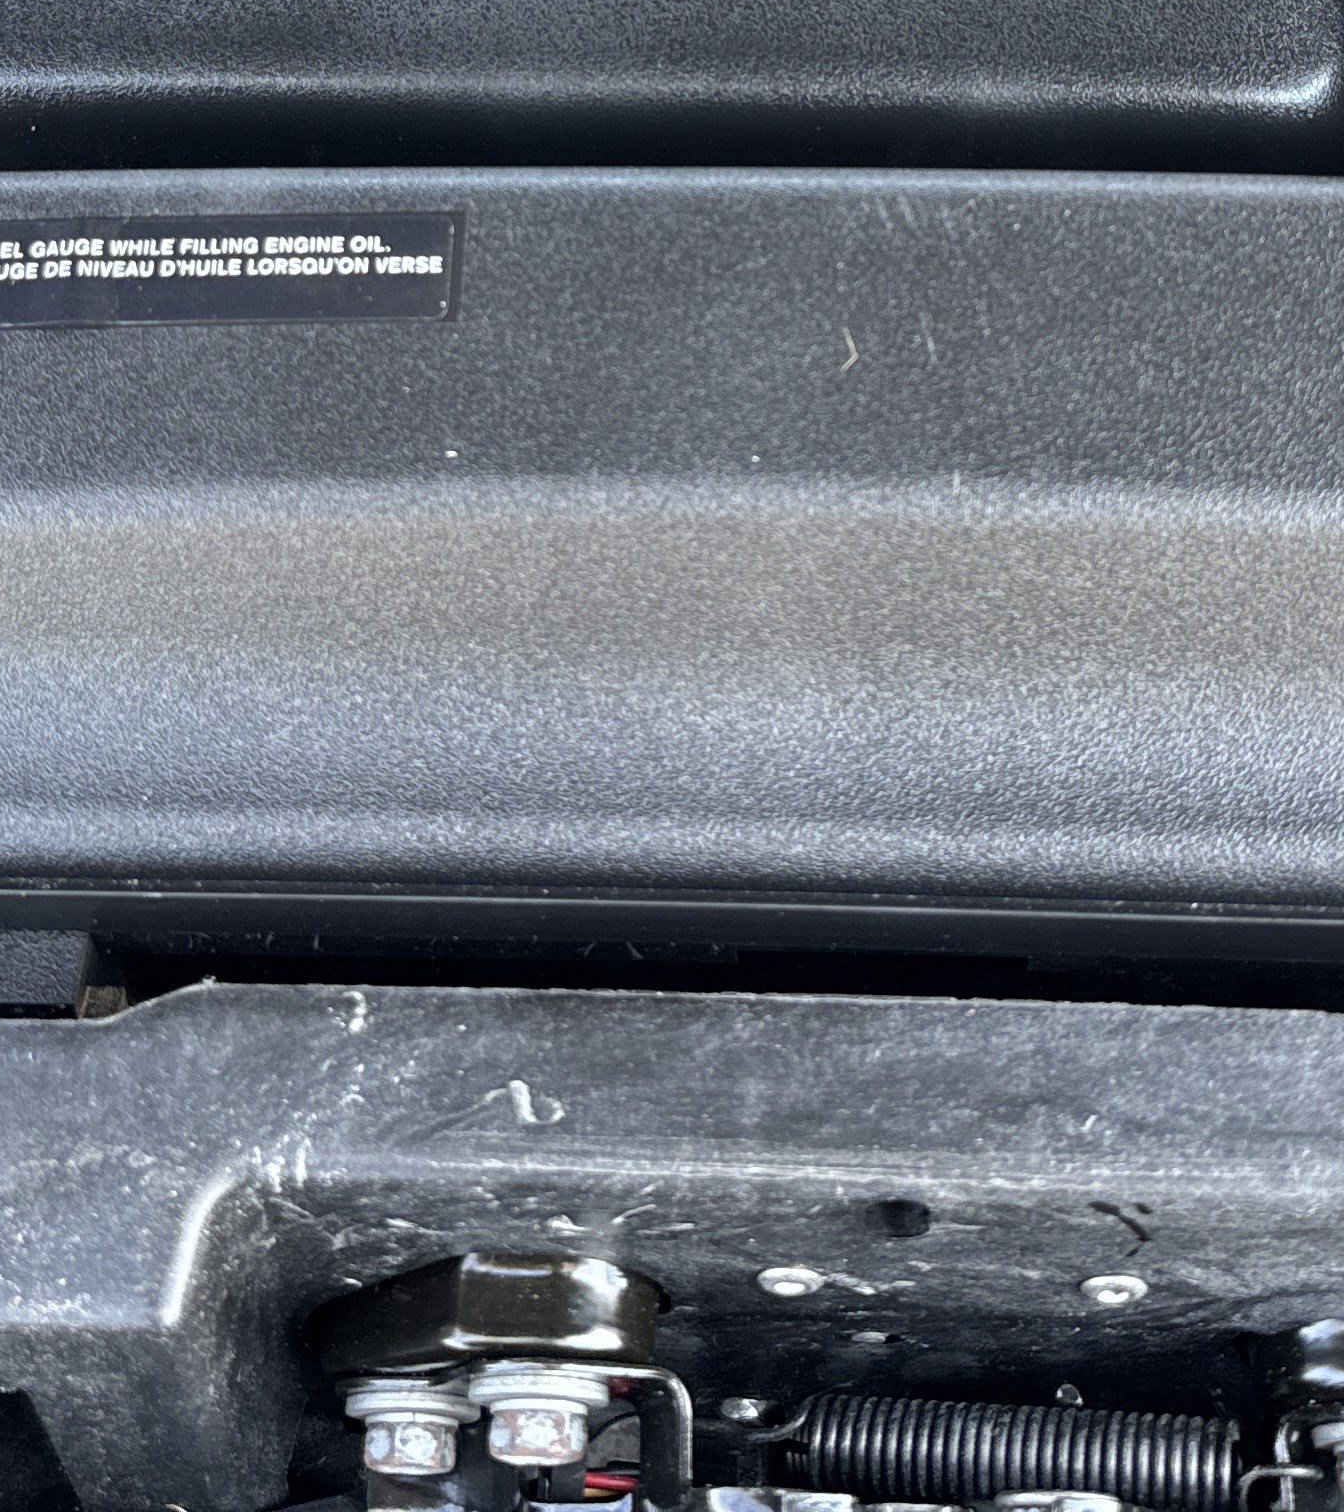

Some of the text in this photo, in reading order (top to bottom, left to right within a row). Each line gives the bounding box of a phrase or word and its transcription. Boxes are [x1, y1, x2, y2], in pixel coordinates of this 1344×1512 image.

[29, 238, 105, 259] GAUGE
[109, 238, 176, 257] WHILE
[179, 236, 259, 256] FILLING
[264, 236, 346, 254] ENGINE
[350, 234, 391, 254] OIL.
[43, 260, 72, 280] DE
[77, 259, 154, 279] NIVEAU
[159, 257, 242, 278] D'HUILE
[246, 255, 370, 276] LORSQU'ON
[374, 255, 444, 274] VERSE
